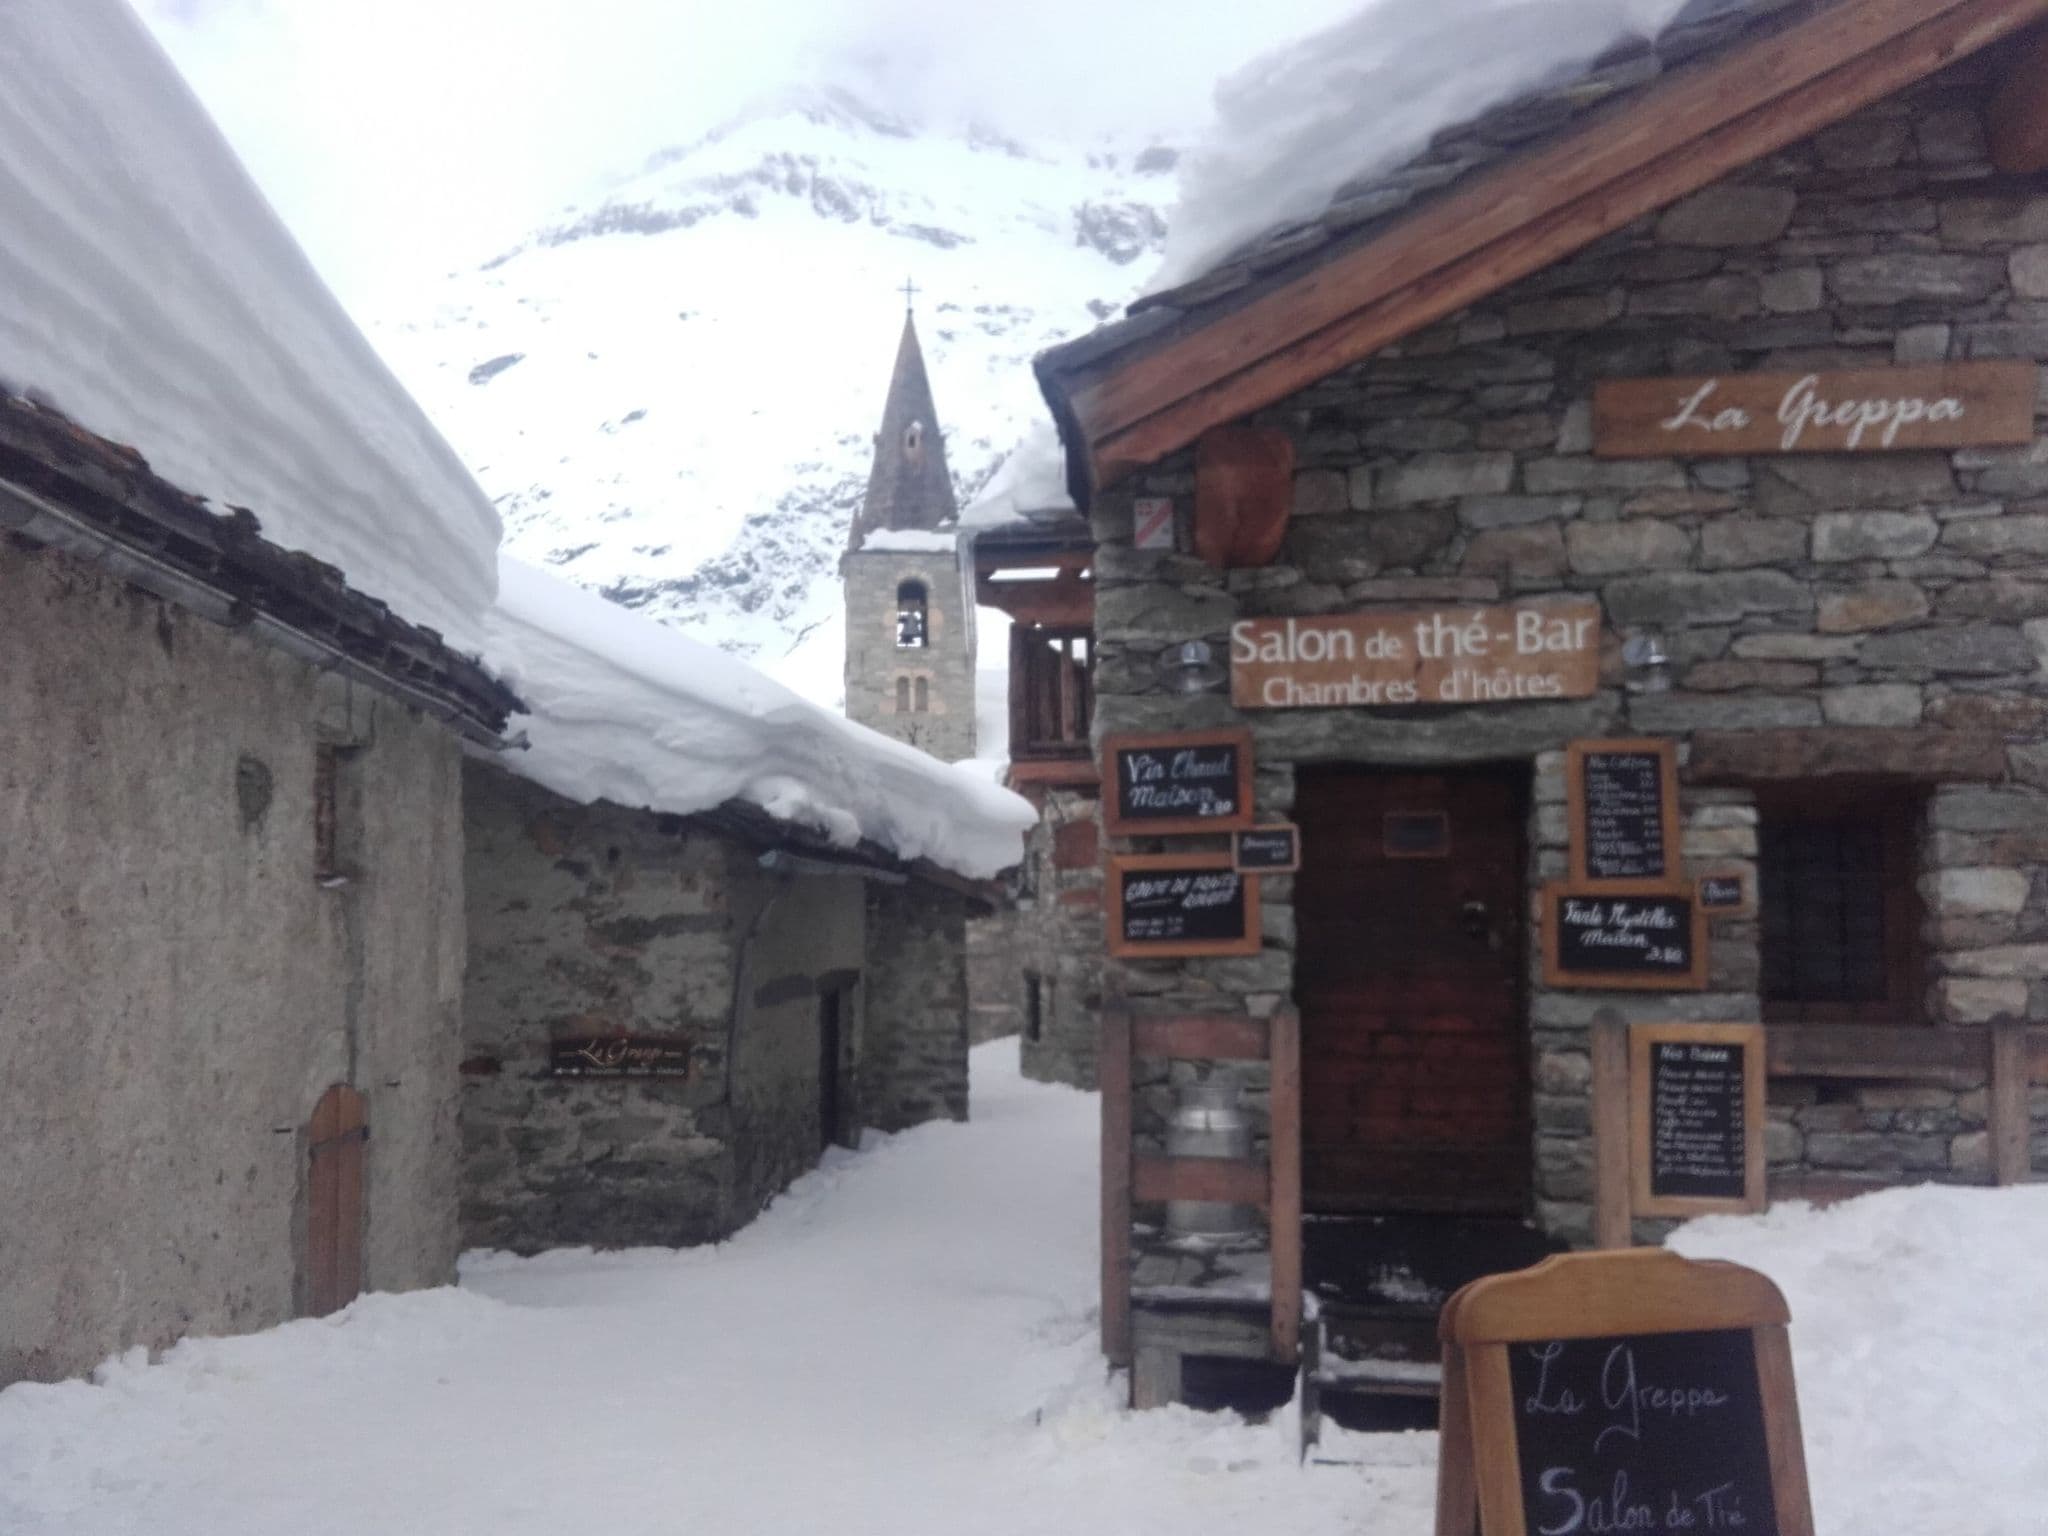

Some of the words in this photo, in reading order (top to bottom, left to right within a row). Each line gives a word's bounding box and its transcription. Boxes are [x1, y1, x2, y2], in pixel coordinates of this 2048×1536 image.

[1661, 378, 1751, 431] La
[1777, 373, 1964, 450] Greppa
[1231, 617, 1355, 664] Salon
[1365, 632, 1402, 658] de
[1263, 674, 1418, 706] Chambres
[1438, 666, 1563, 699] d'hôtes
[1127, 752, 1164, 783] Vin
[1170, 750, 1231, 779] Chaud
[1128, 784, 1217, 808] Maison
[1579, 929, 1649, 949] Maison
[1526, 1342, 1583, 1414] La
[1594, 1343, 1729, 1452] Greppa
[1538, 1466, 1656, 1535] Salon
[1666, 1490, 1695, 1528] de
